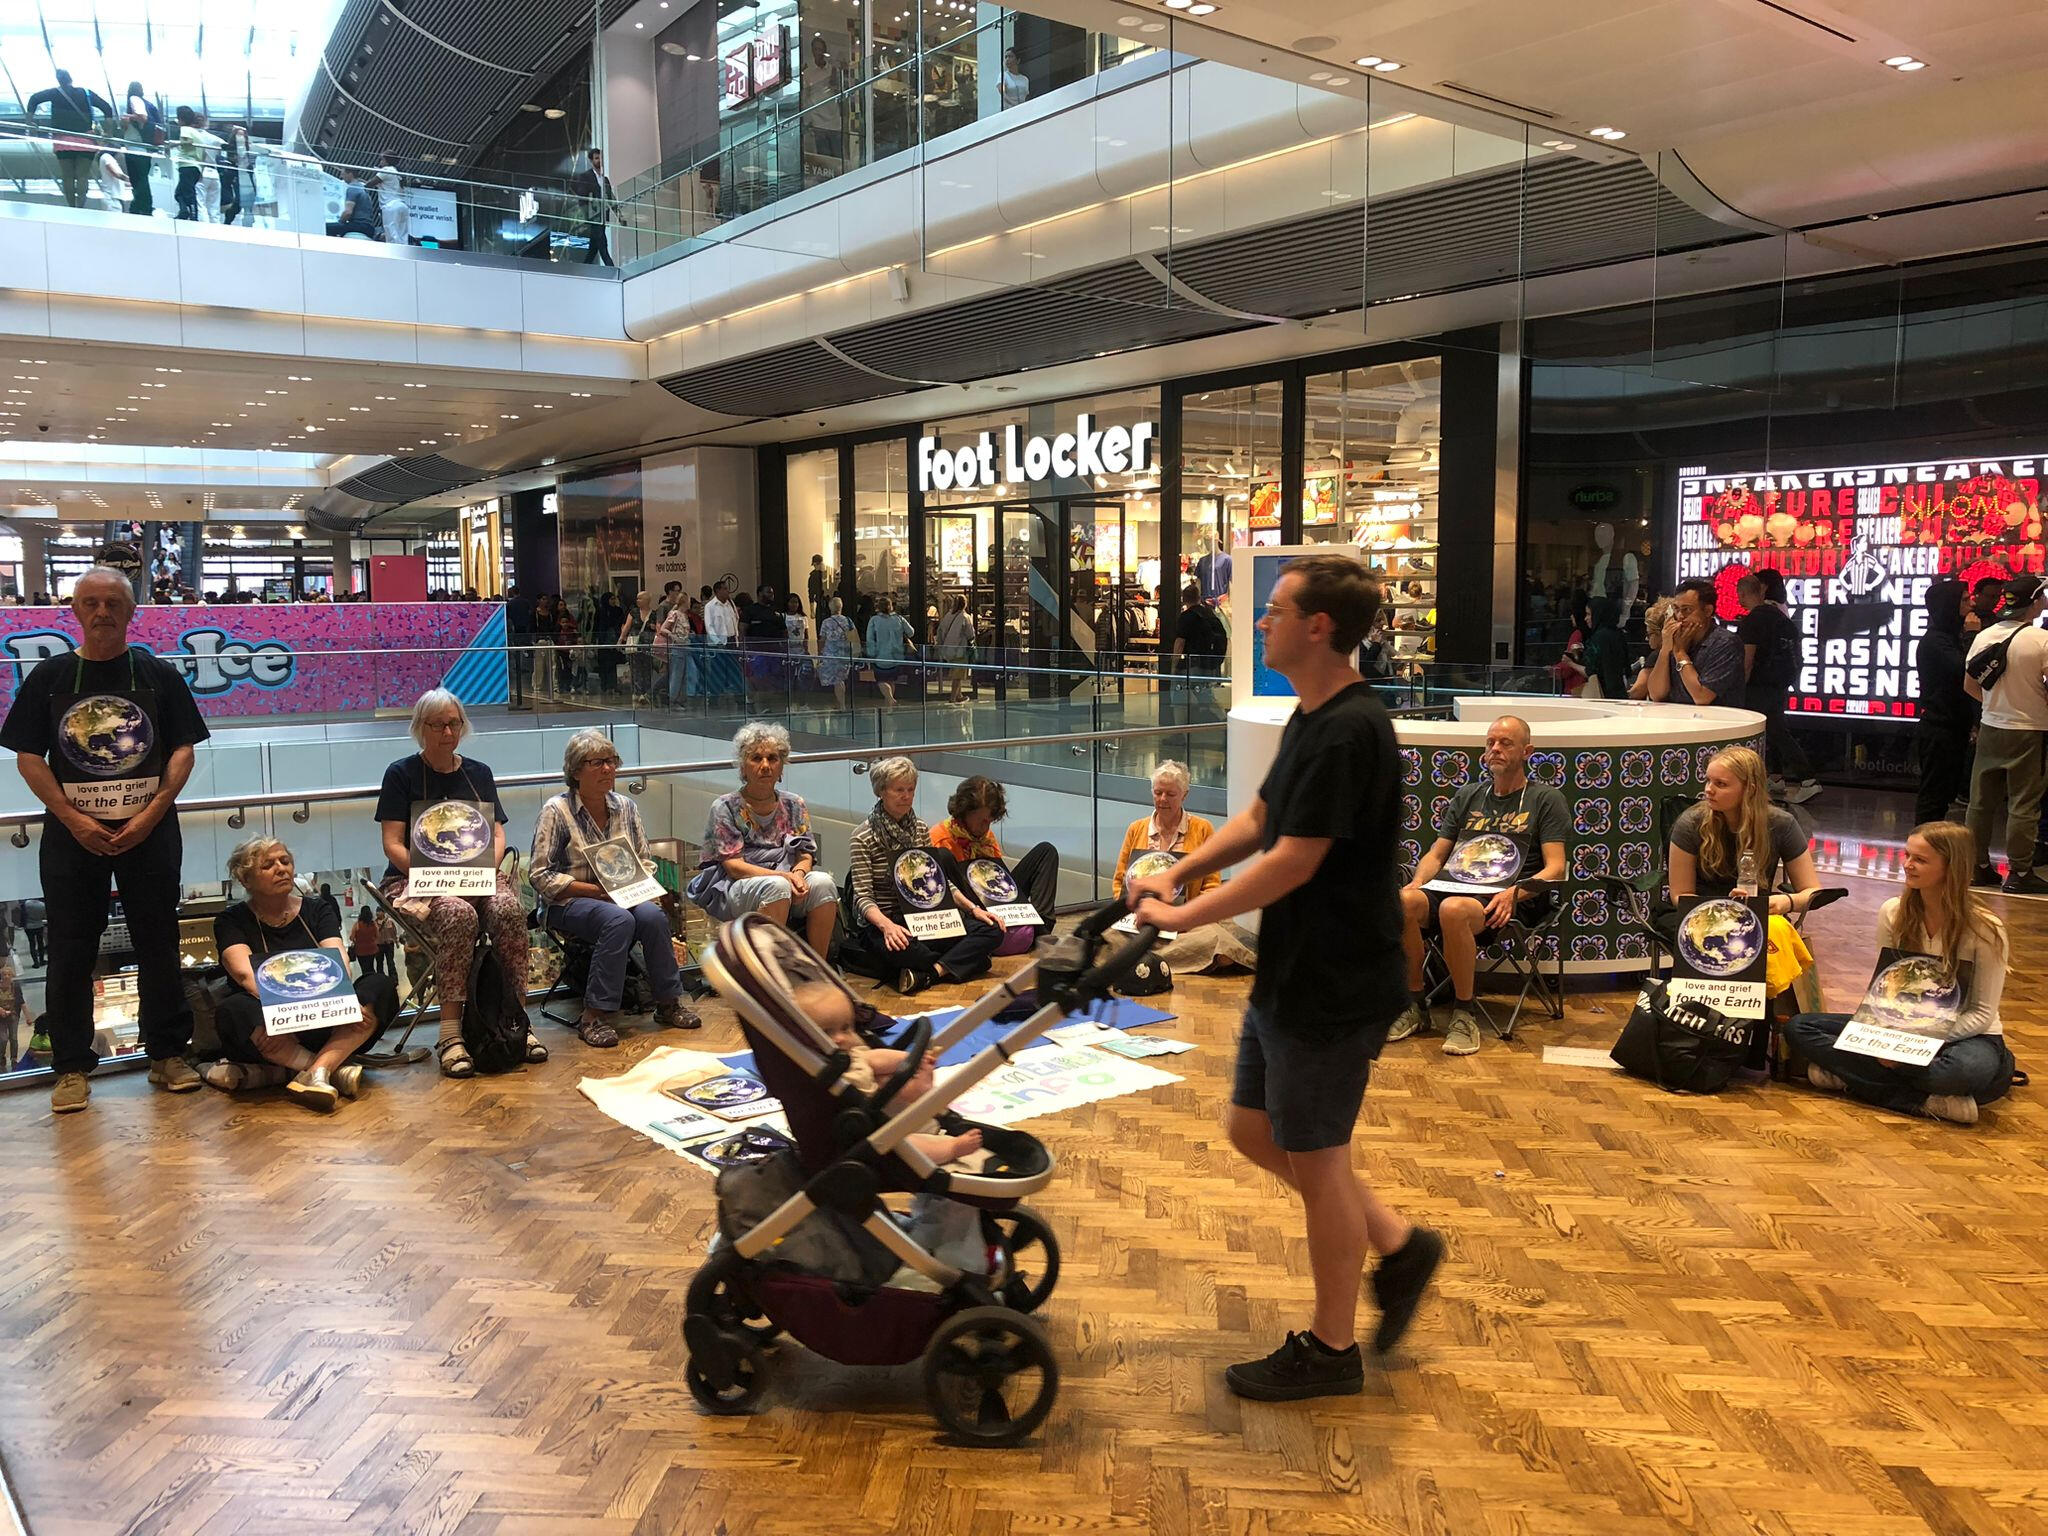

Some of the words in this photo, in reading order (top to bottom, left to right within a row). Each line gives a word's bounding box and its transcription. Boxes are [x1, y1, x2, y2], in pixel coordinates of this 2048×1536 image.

[419, 212, 435, 220] your
[918, 431, 997, 492] Foot
[1005, 413, 1156, 483] Locker
[77, 785, 100, 793] love
[102, 783, 122, 792] and
[125, 781, 147, 792] grief
[73, 797, 91, 808] for
[95, 797, 118, 808] the
[463, 869, 483, 877] grief
[414, 880, 433, 888] for
[436, 879, 456, 888] the
[459, 879, 493, 888] Earth
[912, 924, 923, 933] for
[925, 922, 938, 931] the
[939, 920, 961, 930] Earth
[1685, 981, 1705, 990] love
[1708, 983, 1726, 992] and
[1729, 984, 1752, 994] grief
[277, 1005, 299, 1013] love
[322, 998, 344, 1008] grief
[1675, 993, 1695, 1003] for
[1699, 996, 1720, 1006] the
[1724, 996, 1762, 1009] Earth
[272, 1016, 292, 1027] for
[295, 1013, 317, 1023] the
[321, 1006, 357, 1019] Earth
[1860, 1026, 1881, 1035] love
[1904, 1036, 1928, 1045] grief
[1845, 1033, 1866, 1044] for
[1867, 1039, 1890, 1050] the
[1893, 1043, 1932, 1057] Earth
